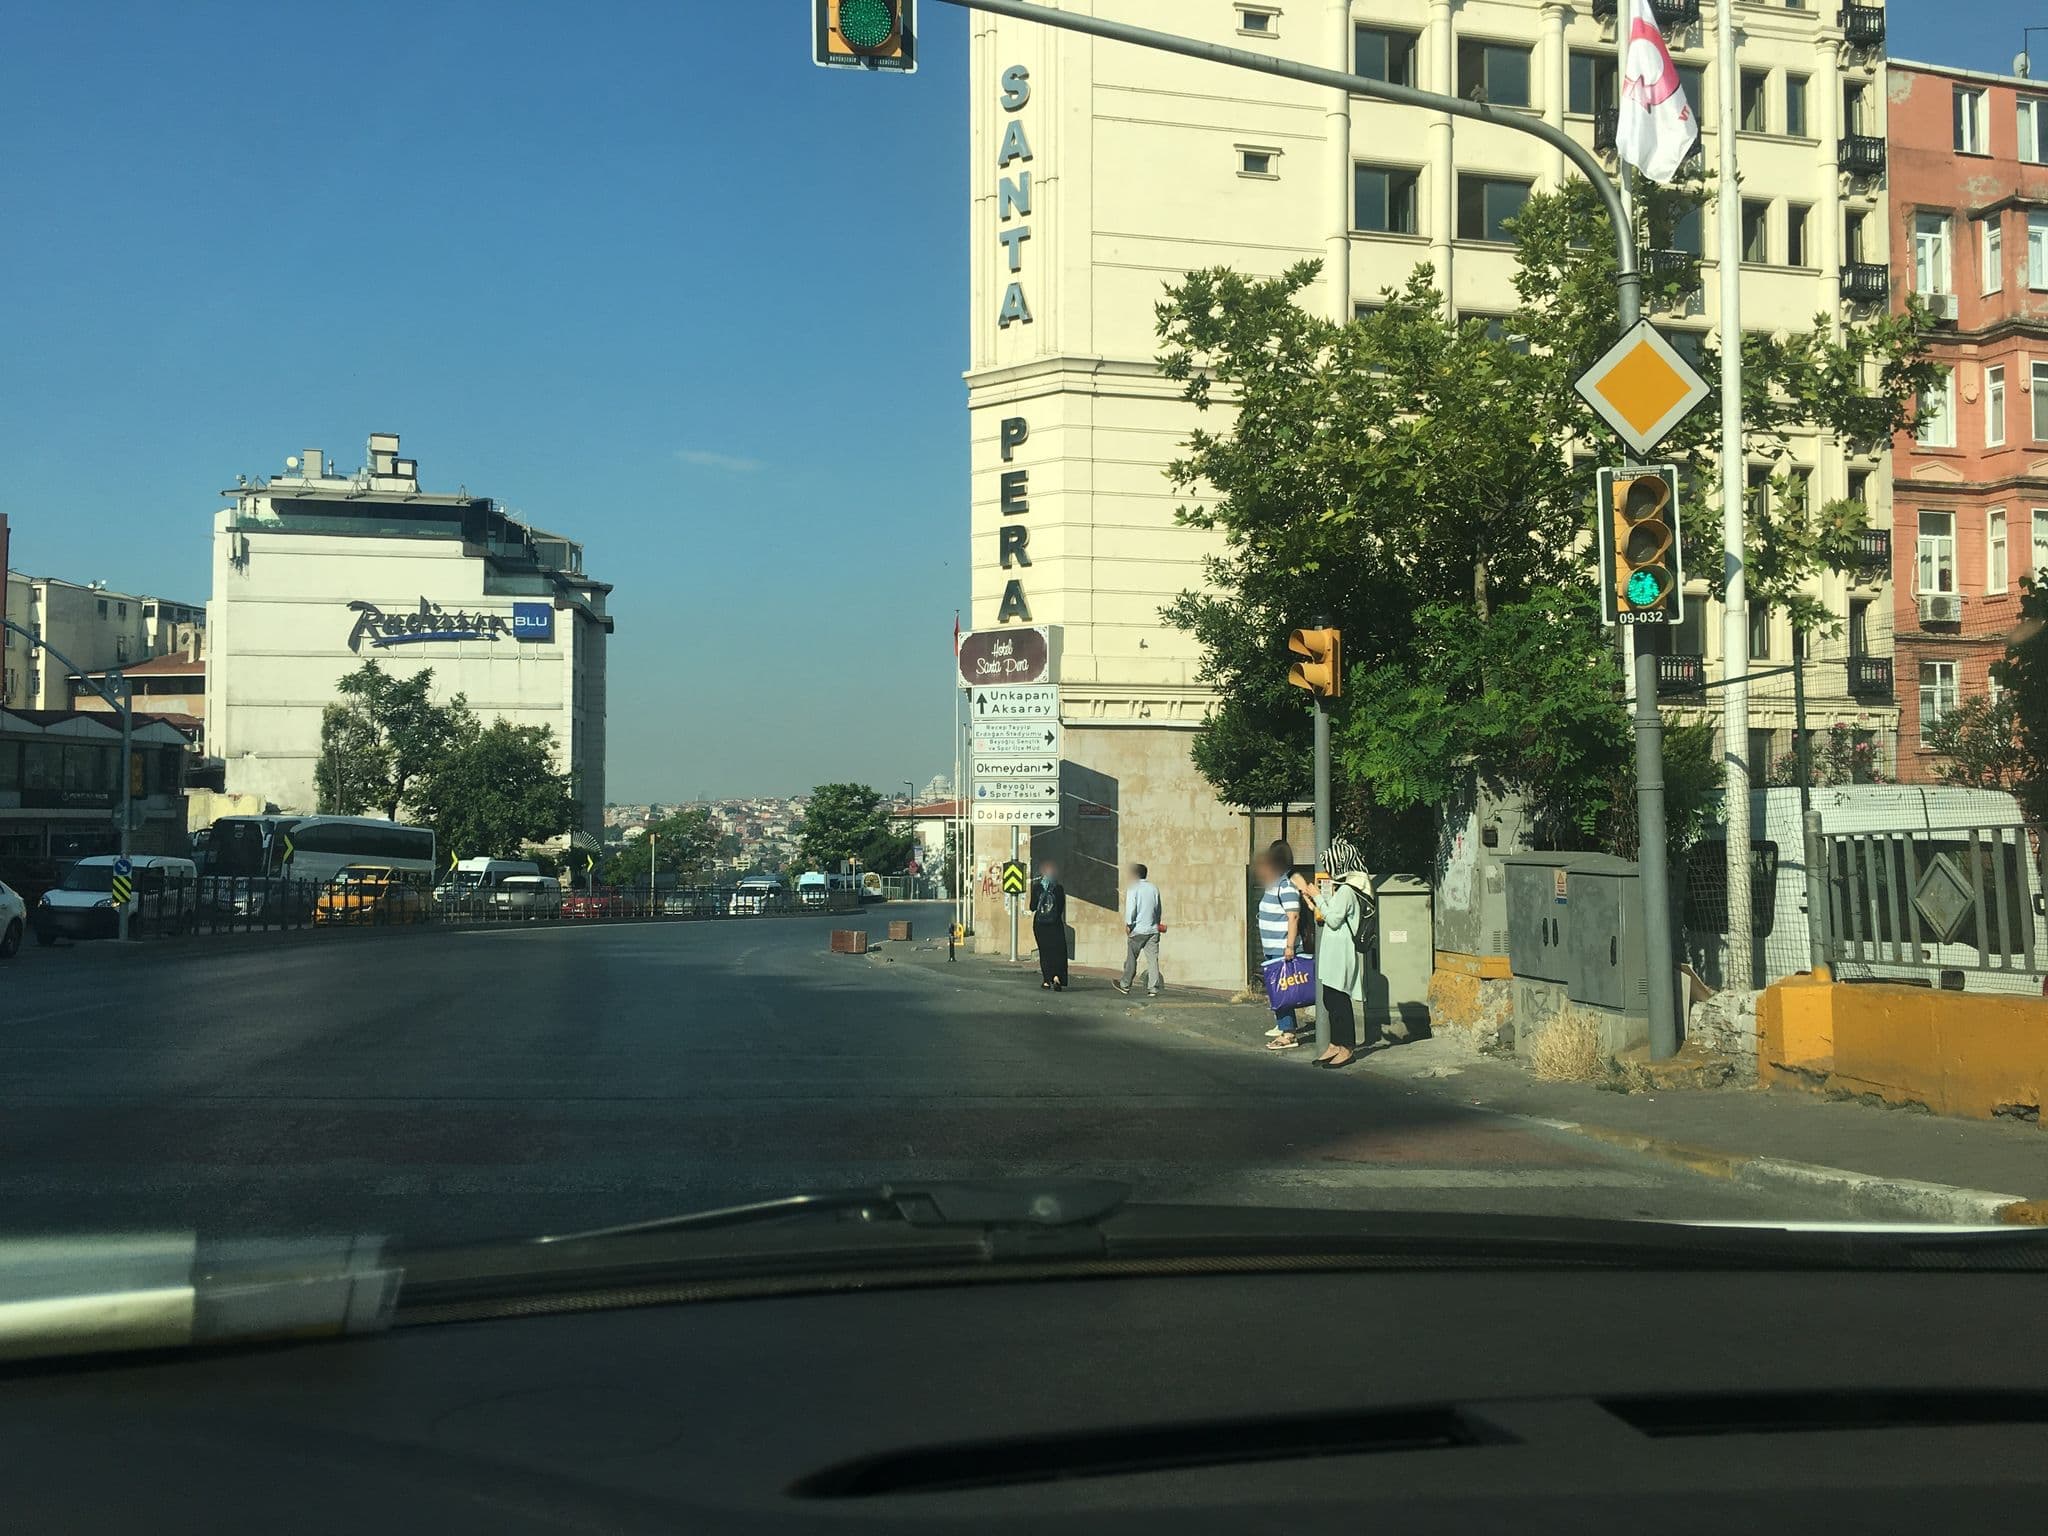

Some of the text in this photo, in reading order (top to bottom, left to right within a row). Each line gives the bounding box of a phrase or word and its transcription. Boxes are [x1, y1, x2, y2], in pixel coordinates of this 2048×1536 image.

[997, 64, 1033, 624] SANTA PERA
[1619, 611, 1664, 624] 09-032
[346, 595, 548, 654] Radisson BLU
[991, 638, 1014, 657] Hotel
[976, 657, 1002, 674] Santa
[990, 691, 1054, 703] Unkapanı
[991, 704, 1051, 715] Aksaray
[976, 763, 1041, 775] Okmeydanı
[996, 783, 1035, 791] Beyoğlu
[977, 809, 1043, 821] Dolapdere
[1278, 971, 1309, 990] getir
